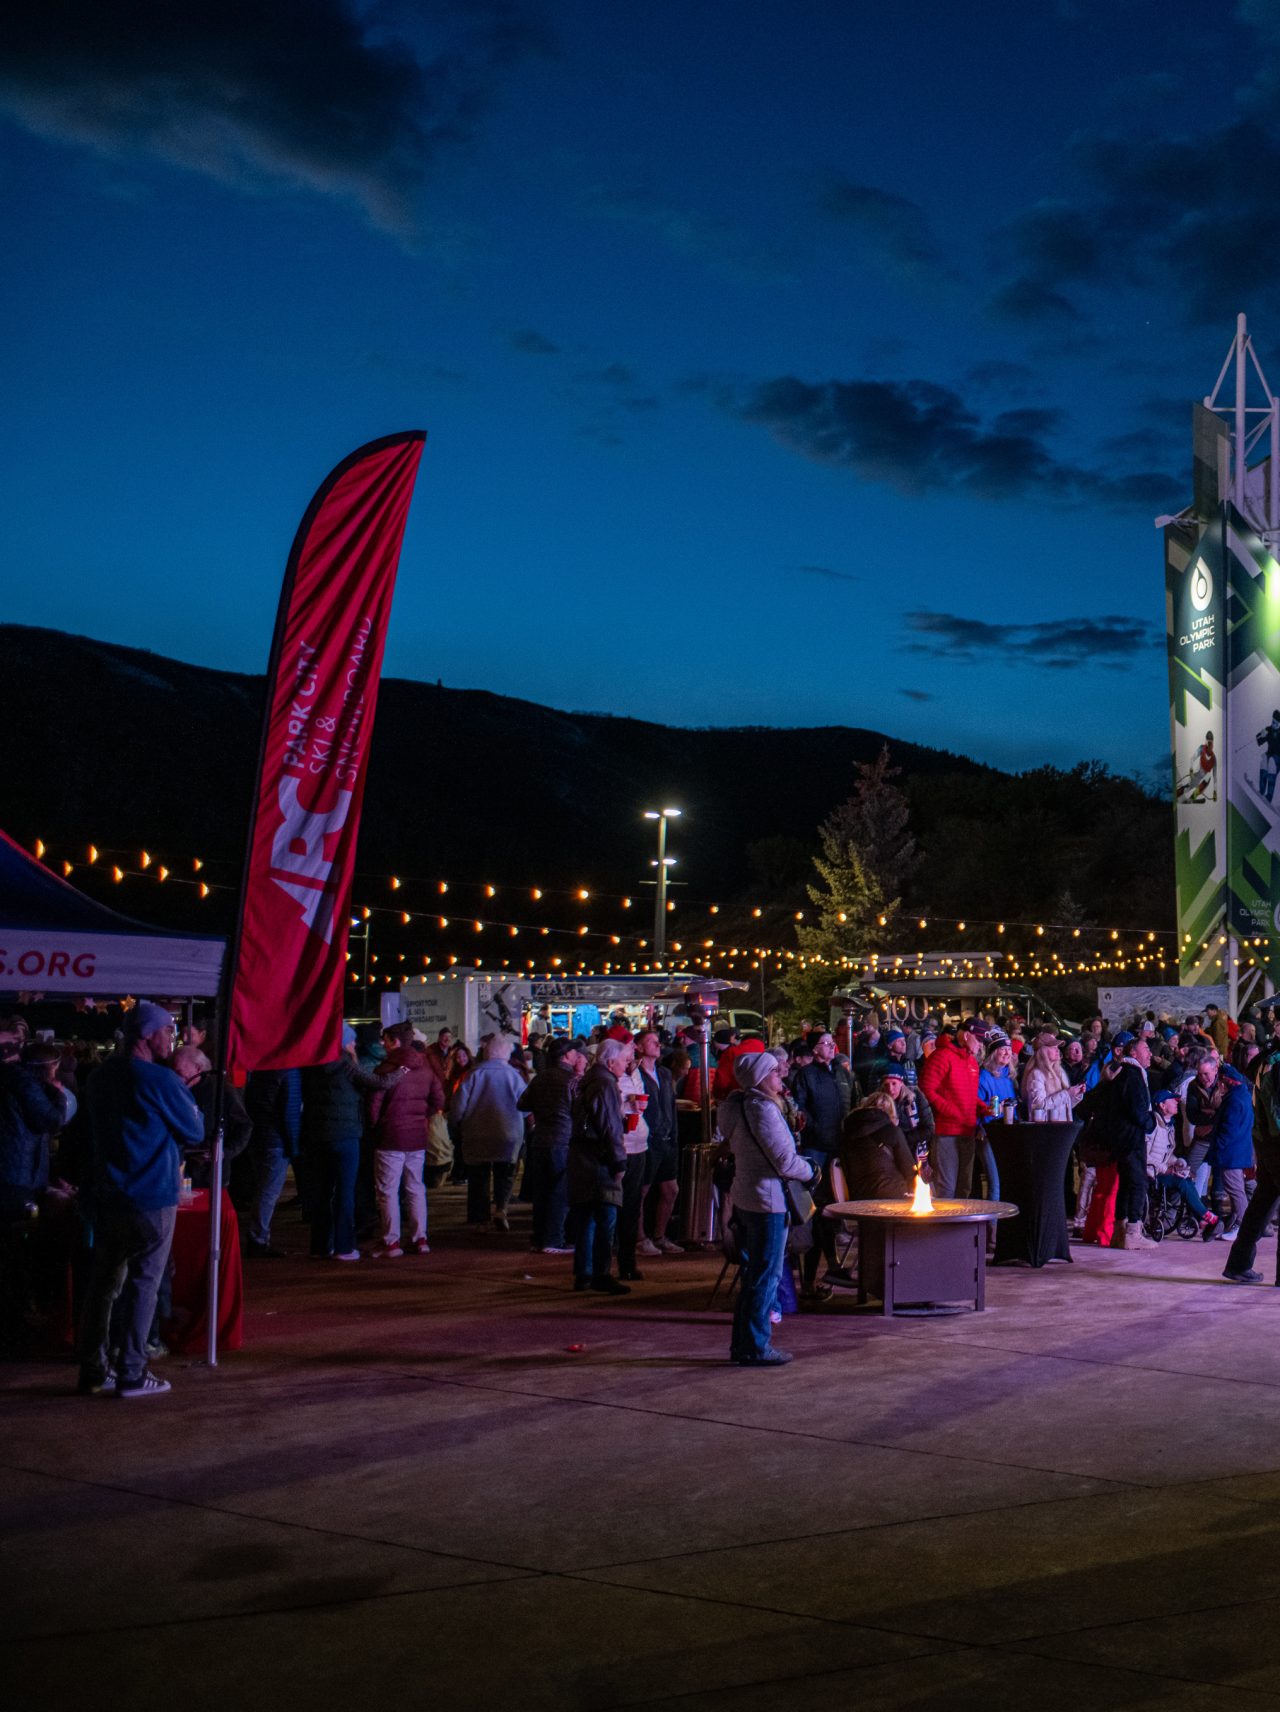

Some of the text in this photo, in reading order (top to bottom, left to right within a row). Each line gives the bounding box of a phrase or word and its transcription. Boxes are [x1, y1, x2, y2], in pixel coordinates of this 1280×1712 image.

[1192, 614, 1215, 630] UTAH
[1180, 626, 1215, 646] OLYMPIC
[1192, 637, 1215, 653] PARK
[283, 640, 319, 769] PARK CITY
[309, 716, 336, 774] SKI &
[1252, 899, 1271, 908] UTAH
[1240, 908, 1271, 918] OLYMPIC
[1251, 919, 1270, 928] PARK
